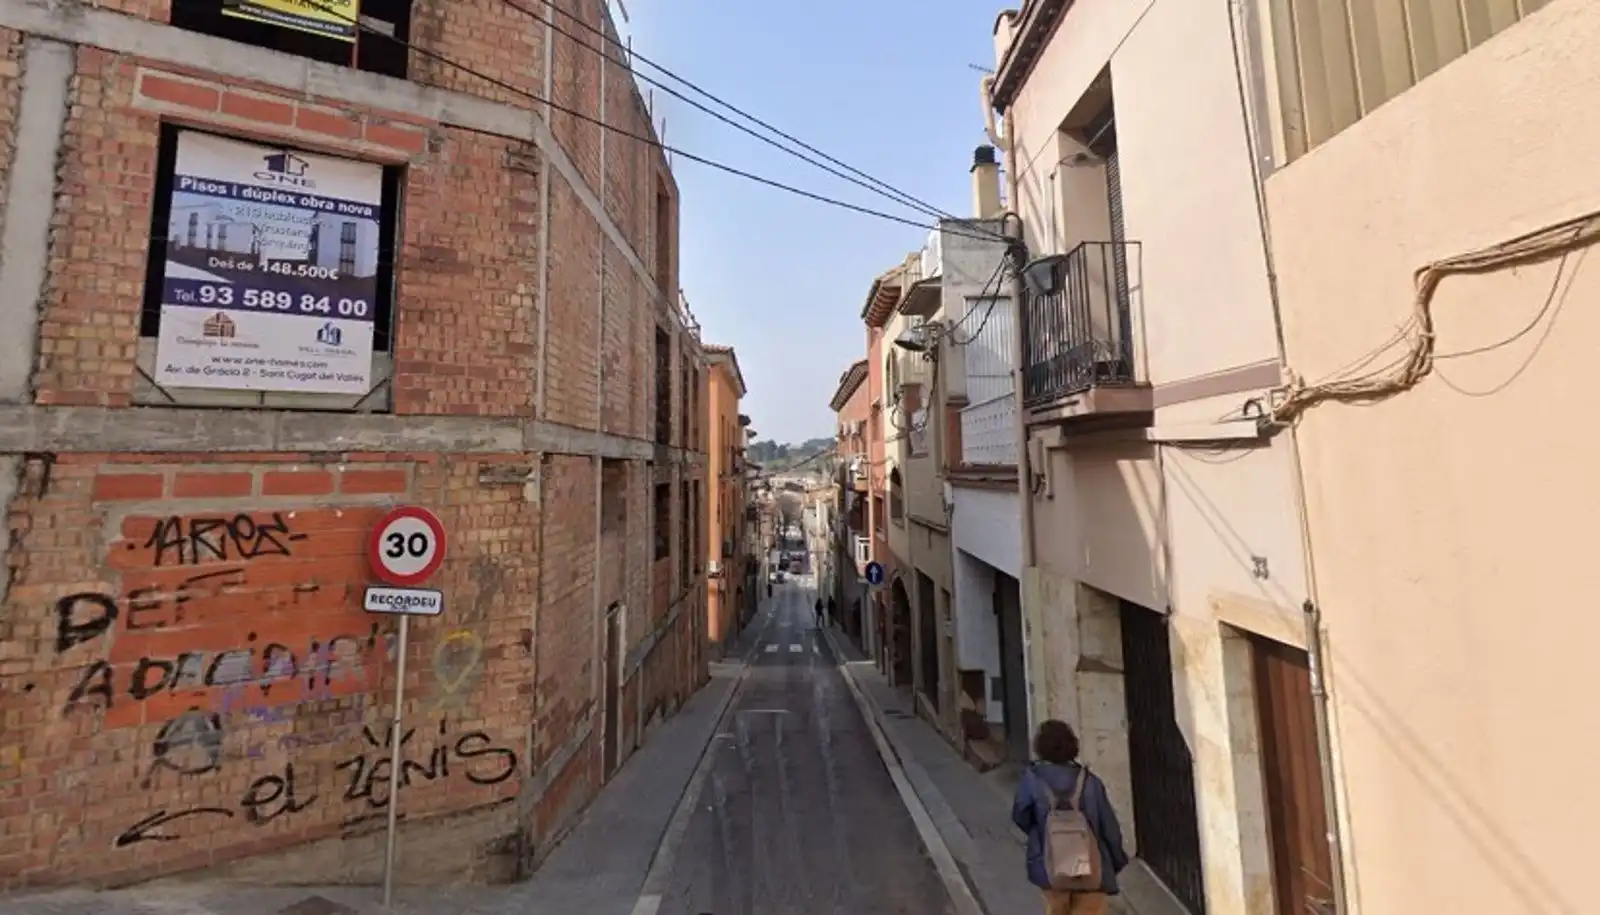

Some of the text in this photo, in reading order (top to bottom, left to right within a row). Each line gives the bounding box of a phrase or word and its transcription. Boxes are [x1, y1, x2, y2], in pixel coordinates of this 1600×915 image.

[253, 171, 316, 189] ONE
[180, 177, 227, 195] Pisos
[242, 186, 297, 206] dúplex
[301, 195, 334, 211] obra
[337, 203, 373, 217] nova
[236, 259, 254, 271] de
[258, 261, 341, 281] 148.500€
[174, 284, 368, 318] Tel. 93 589 84 00
[185, 366, 202, 375] de
[259, 369, 286, 379] Sant
[286, 370, 317, 382] Cugat
[318, 372, 335, 382] del
[386, 531, 428, 558] 30
[370, 592, 437, 608] RECORDEU
